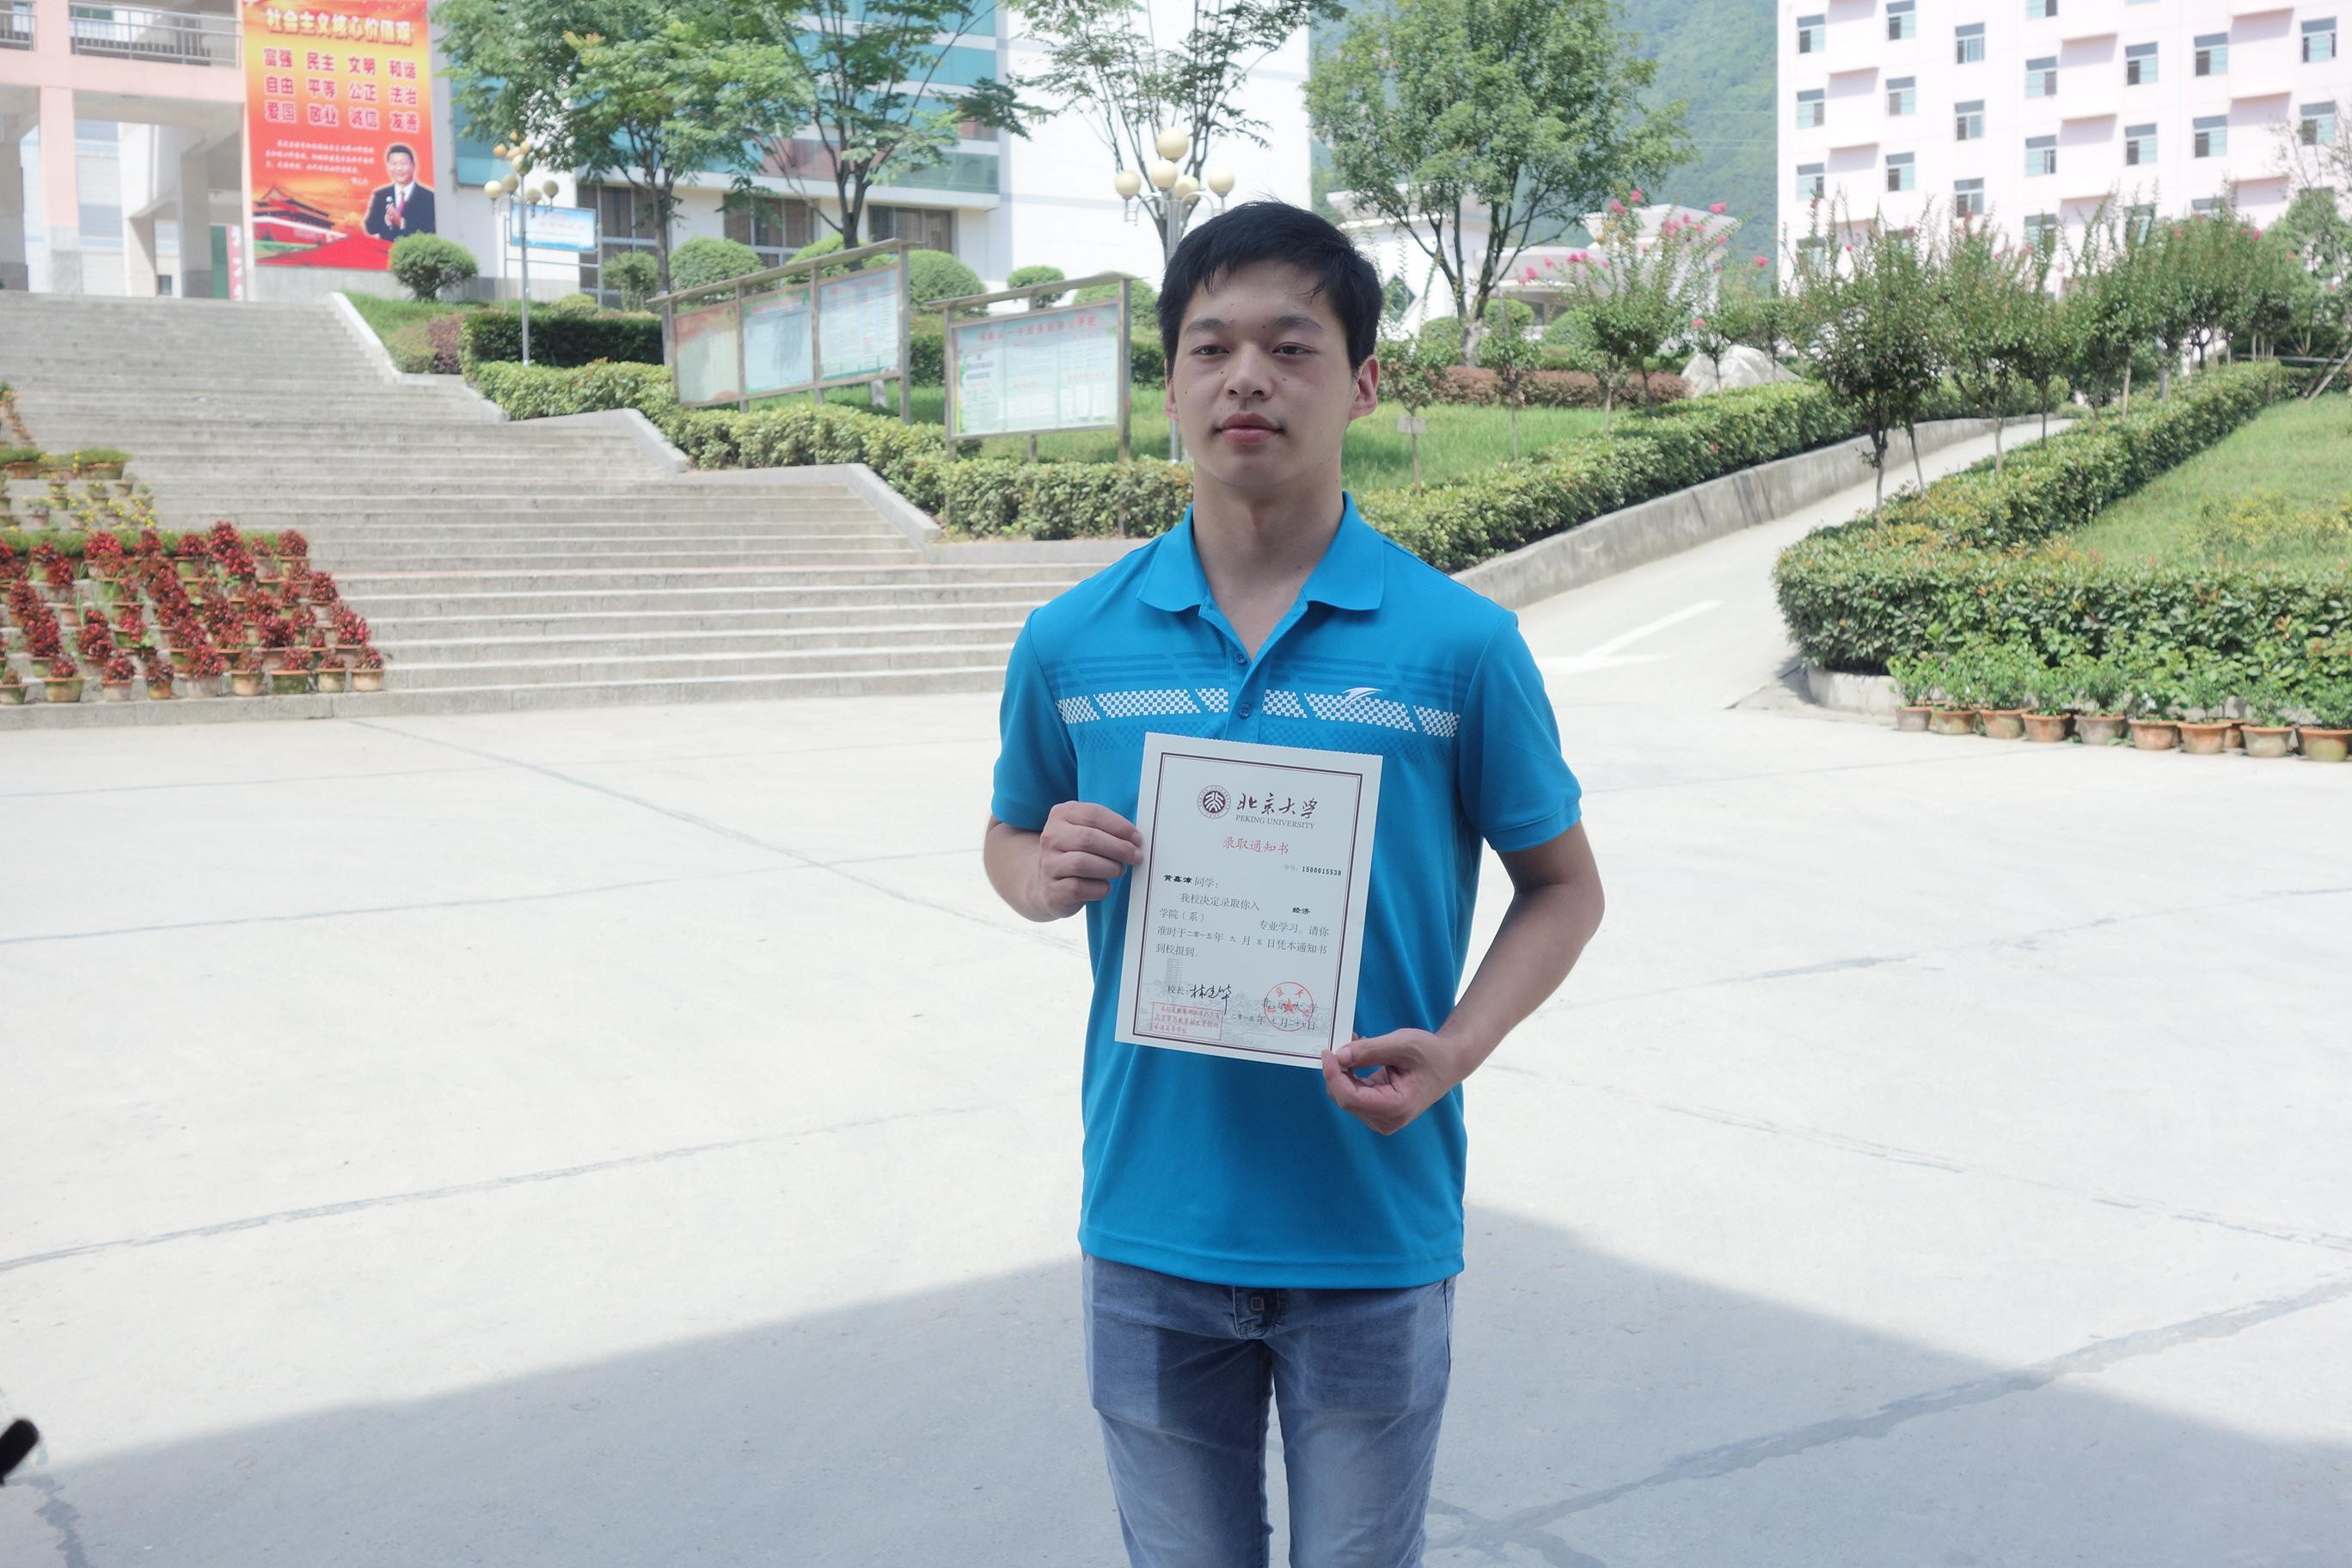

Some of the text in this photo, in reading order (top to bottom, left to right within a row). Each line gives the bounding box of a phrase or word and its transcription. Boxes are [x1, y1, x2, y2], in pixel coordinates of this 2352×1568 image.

[266, 7, 413, 46] 社会主义核心价值观
[264, 48, 416, 79] 富强 民主 文明 和谐
[266, 77, 417, 105] 自由 平等 公正 法治
[266, 101, 418, 131] 爱国 敬业 诚信 友善
[1237, 793, 1317, 818] 北京大学
[1236, 815, 1315, 830] PEKING UNIVERSITY
[1223, 836, 1289, 854] 录取通知书
[1180, 893, 1259, 910] 我校决定录取你入
